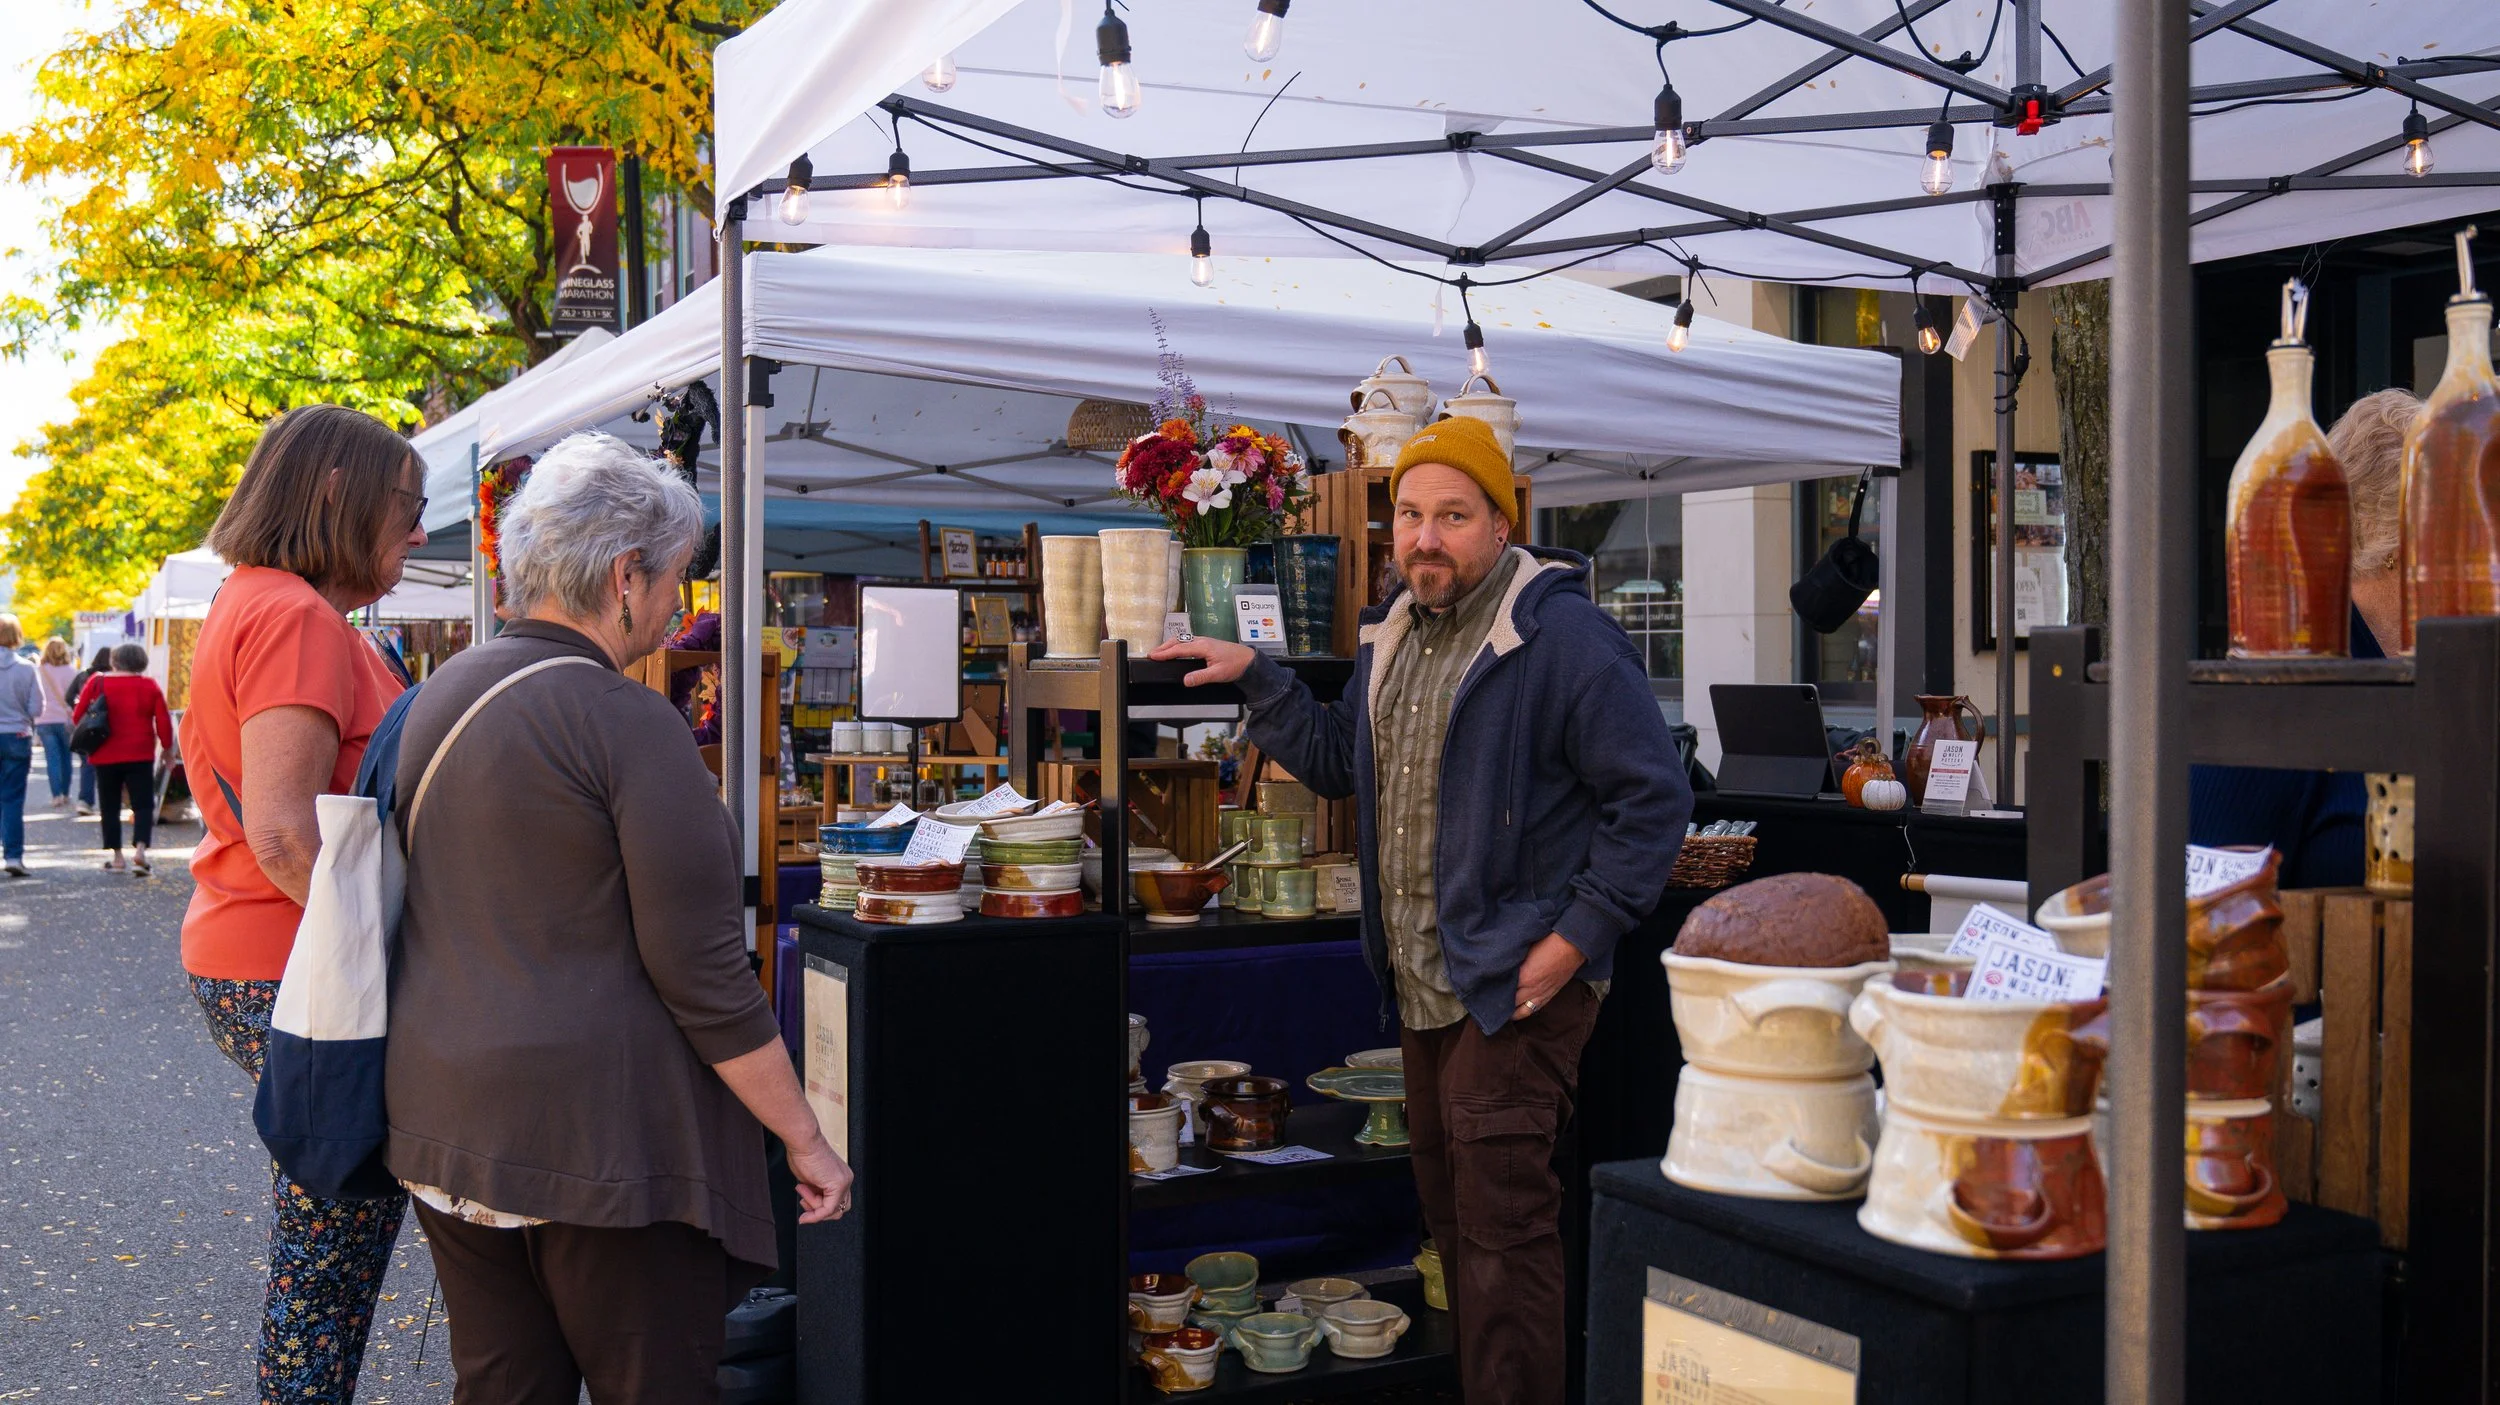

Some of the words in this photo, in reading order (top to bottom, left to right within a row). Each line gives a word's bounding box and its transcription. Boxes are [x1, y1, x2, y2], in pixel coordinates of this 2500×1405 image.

[560, 277, 615, 289] WINEGLASS
[559, 289, 615, 300] MARATHON
[561, 309, 577, 318] 26.2
[1250, 602, 1275, 610] Square
[1943, 745, 1964, 753] JASON
[920, 822, 948, 835] JASON
[1971, 912, 2020, 939] JASON
[1991, 950, 2068, 986] JASON
[1656, 1349, 1711, 1388] JASON
